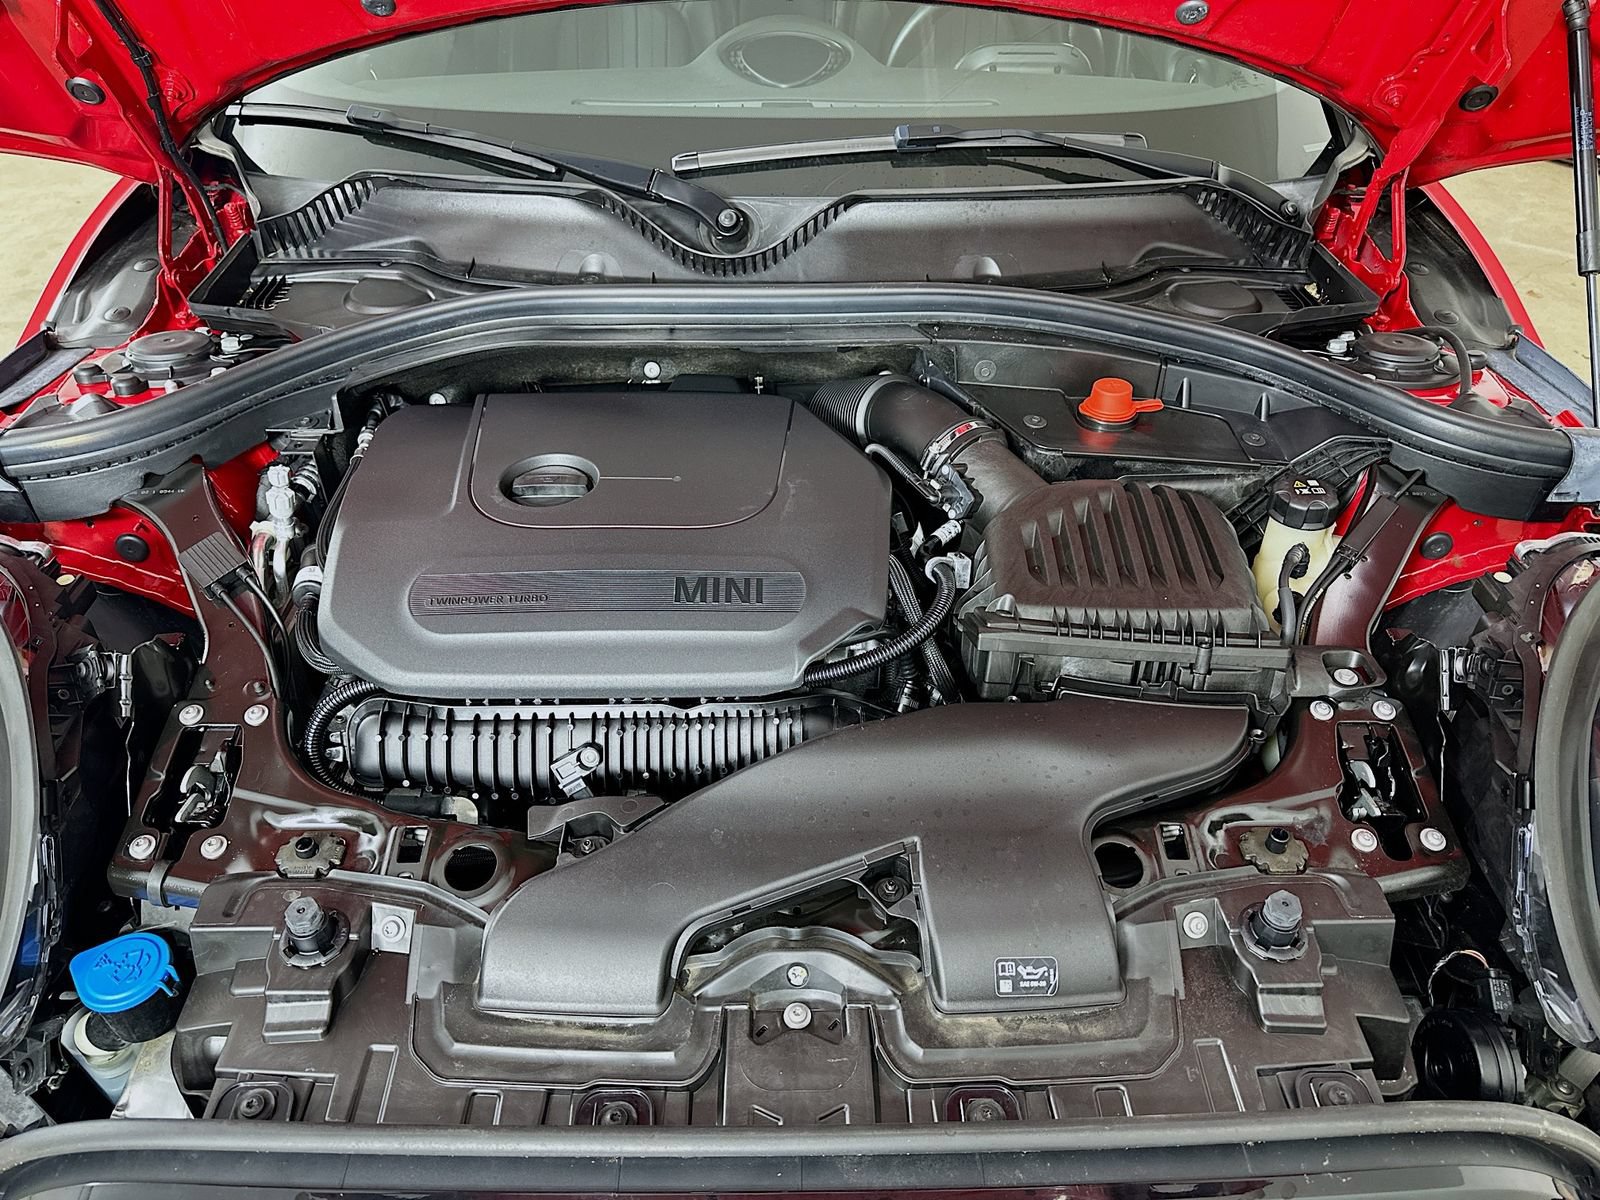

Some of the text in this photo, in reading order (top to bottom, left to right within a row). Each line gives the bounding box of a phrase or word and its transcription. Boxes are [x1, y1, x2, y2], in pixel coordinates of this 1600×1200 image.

[427, 593, 549, 607] TWINPOWER TURBO
[673, 576, 764, 604] MINI
